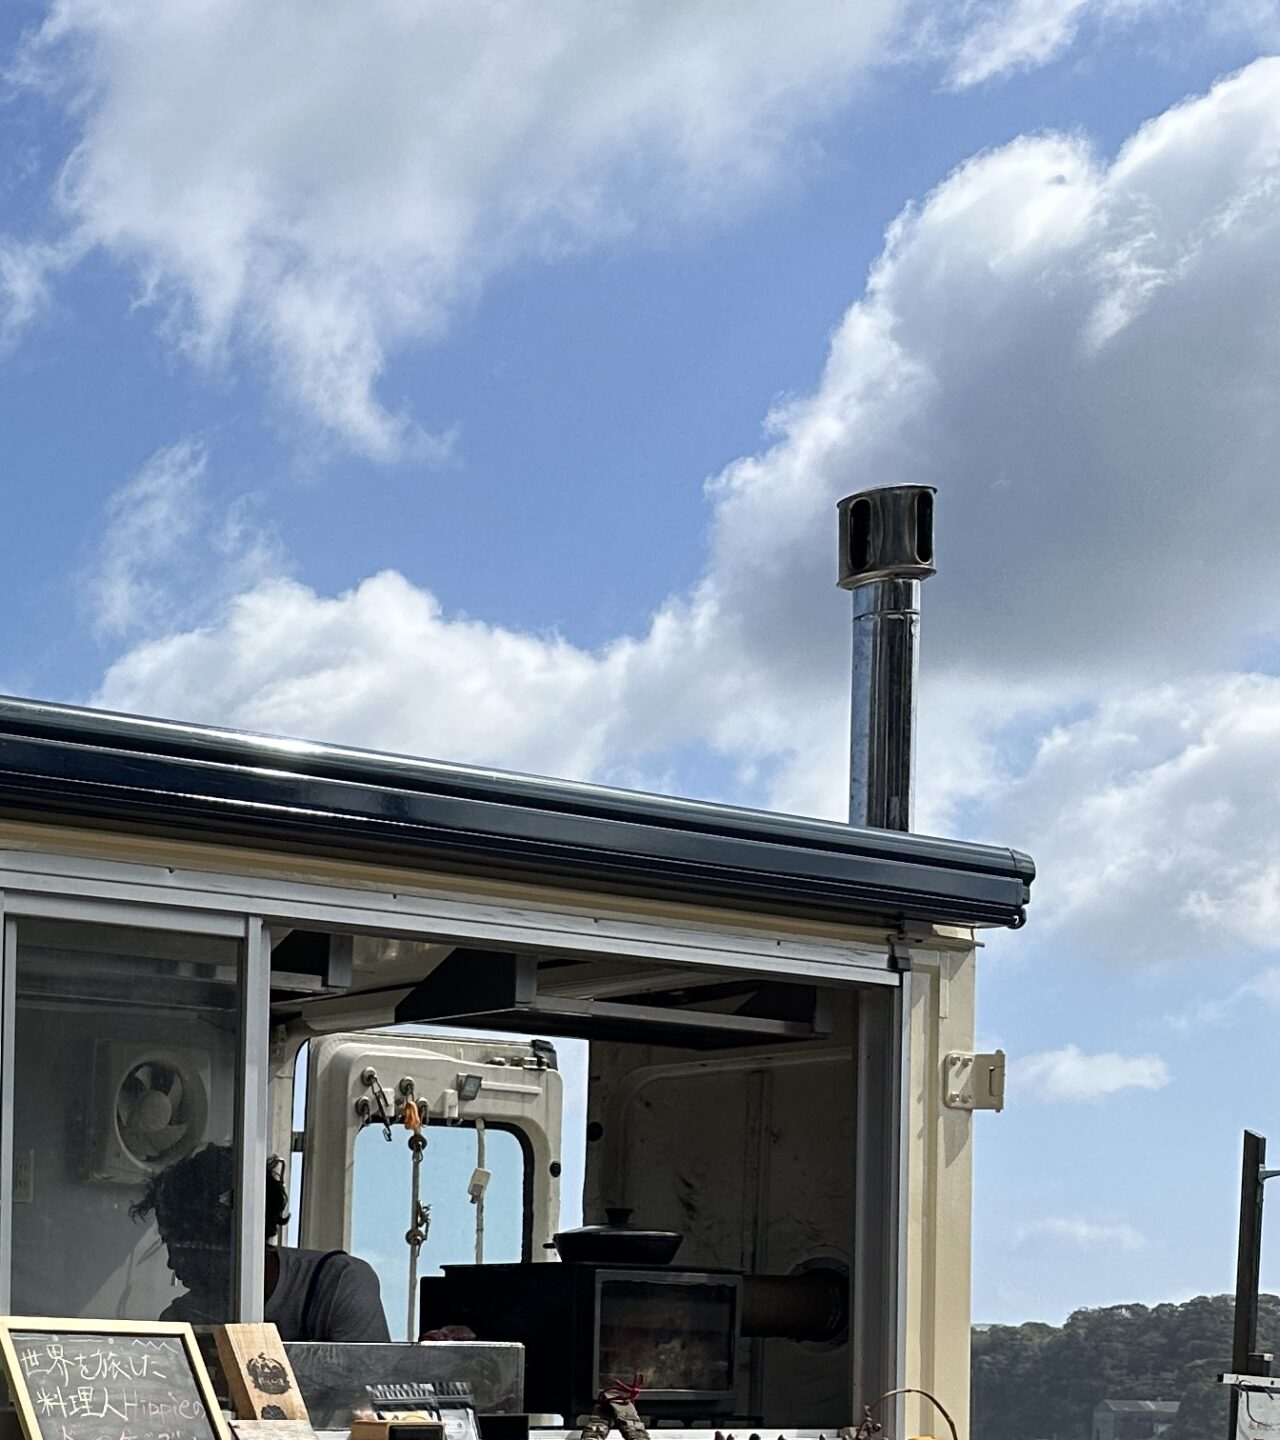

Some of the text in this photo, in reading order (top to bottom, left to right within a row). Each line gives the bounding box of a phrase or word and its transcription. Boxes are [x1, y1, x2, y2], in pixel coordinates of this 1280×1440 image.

[20, 1344, 167, 1387] 世界を旅した
